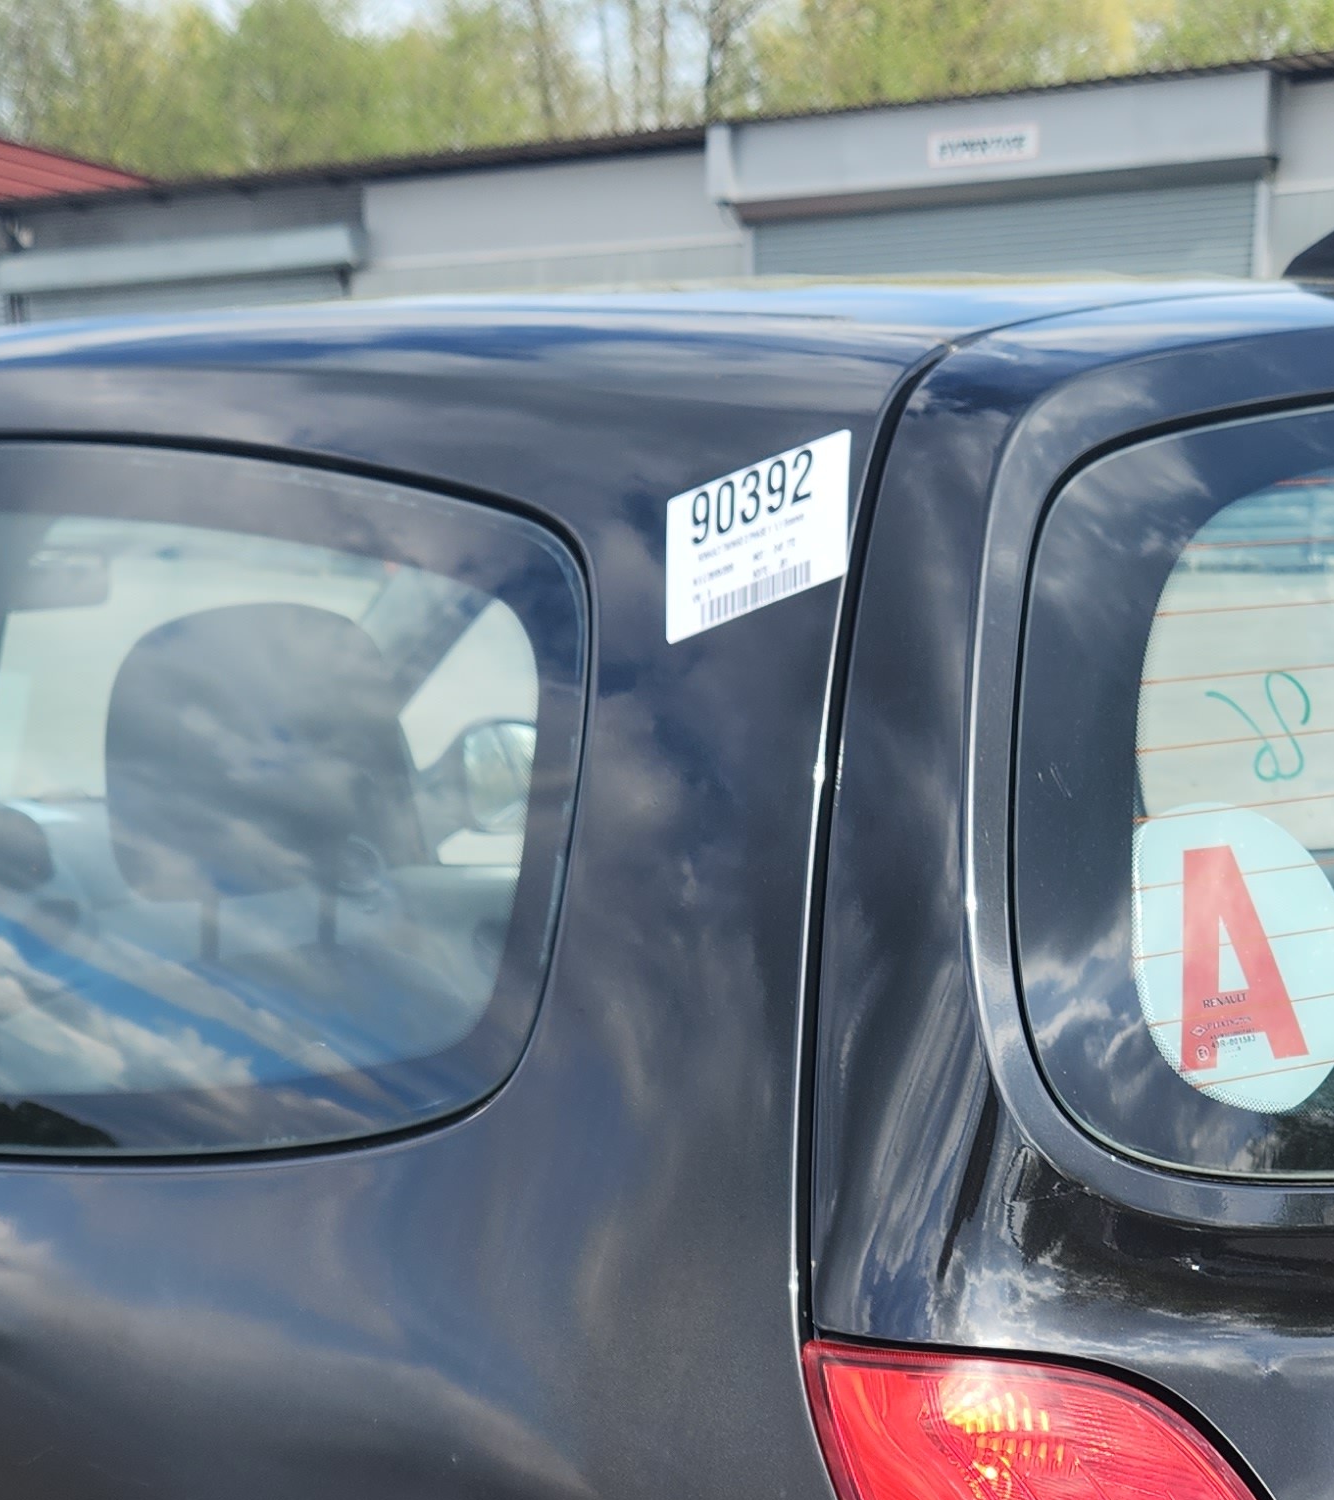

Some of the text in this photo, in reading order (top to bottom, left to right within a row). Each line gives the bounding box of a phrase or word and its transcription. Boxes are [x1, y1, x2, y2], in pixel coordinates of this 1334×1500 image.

[691, 449, 813, 545] 90392
[1179, 845, 1310, 1072] A
[1203, 993, 1247, 1009] RENAULT
